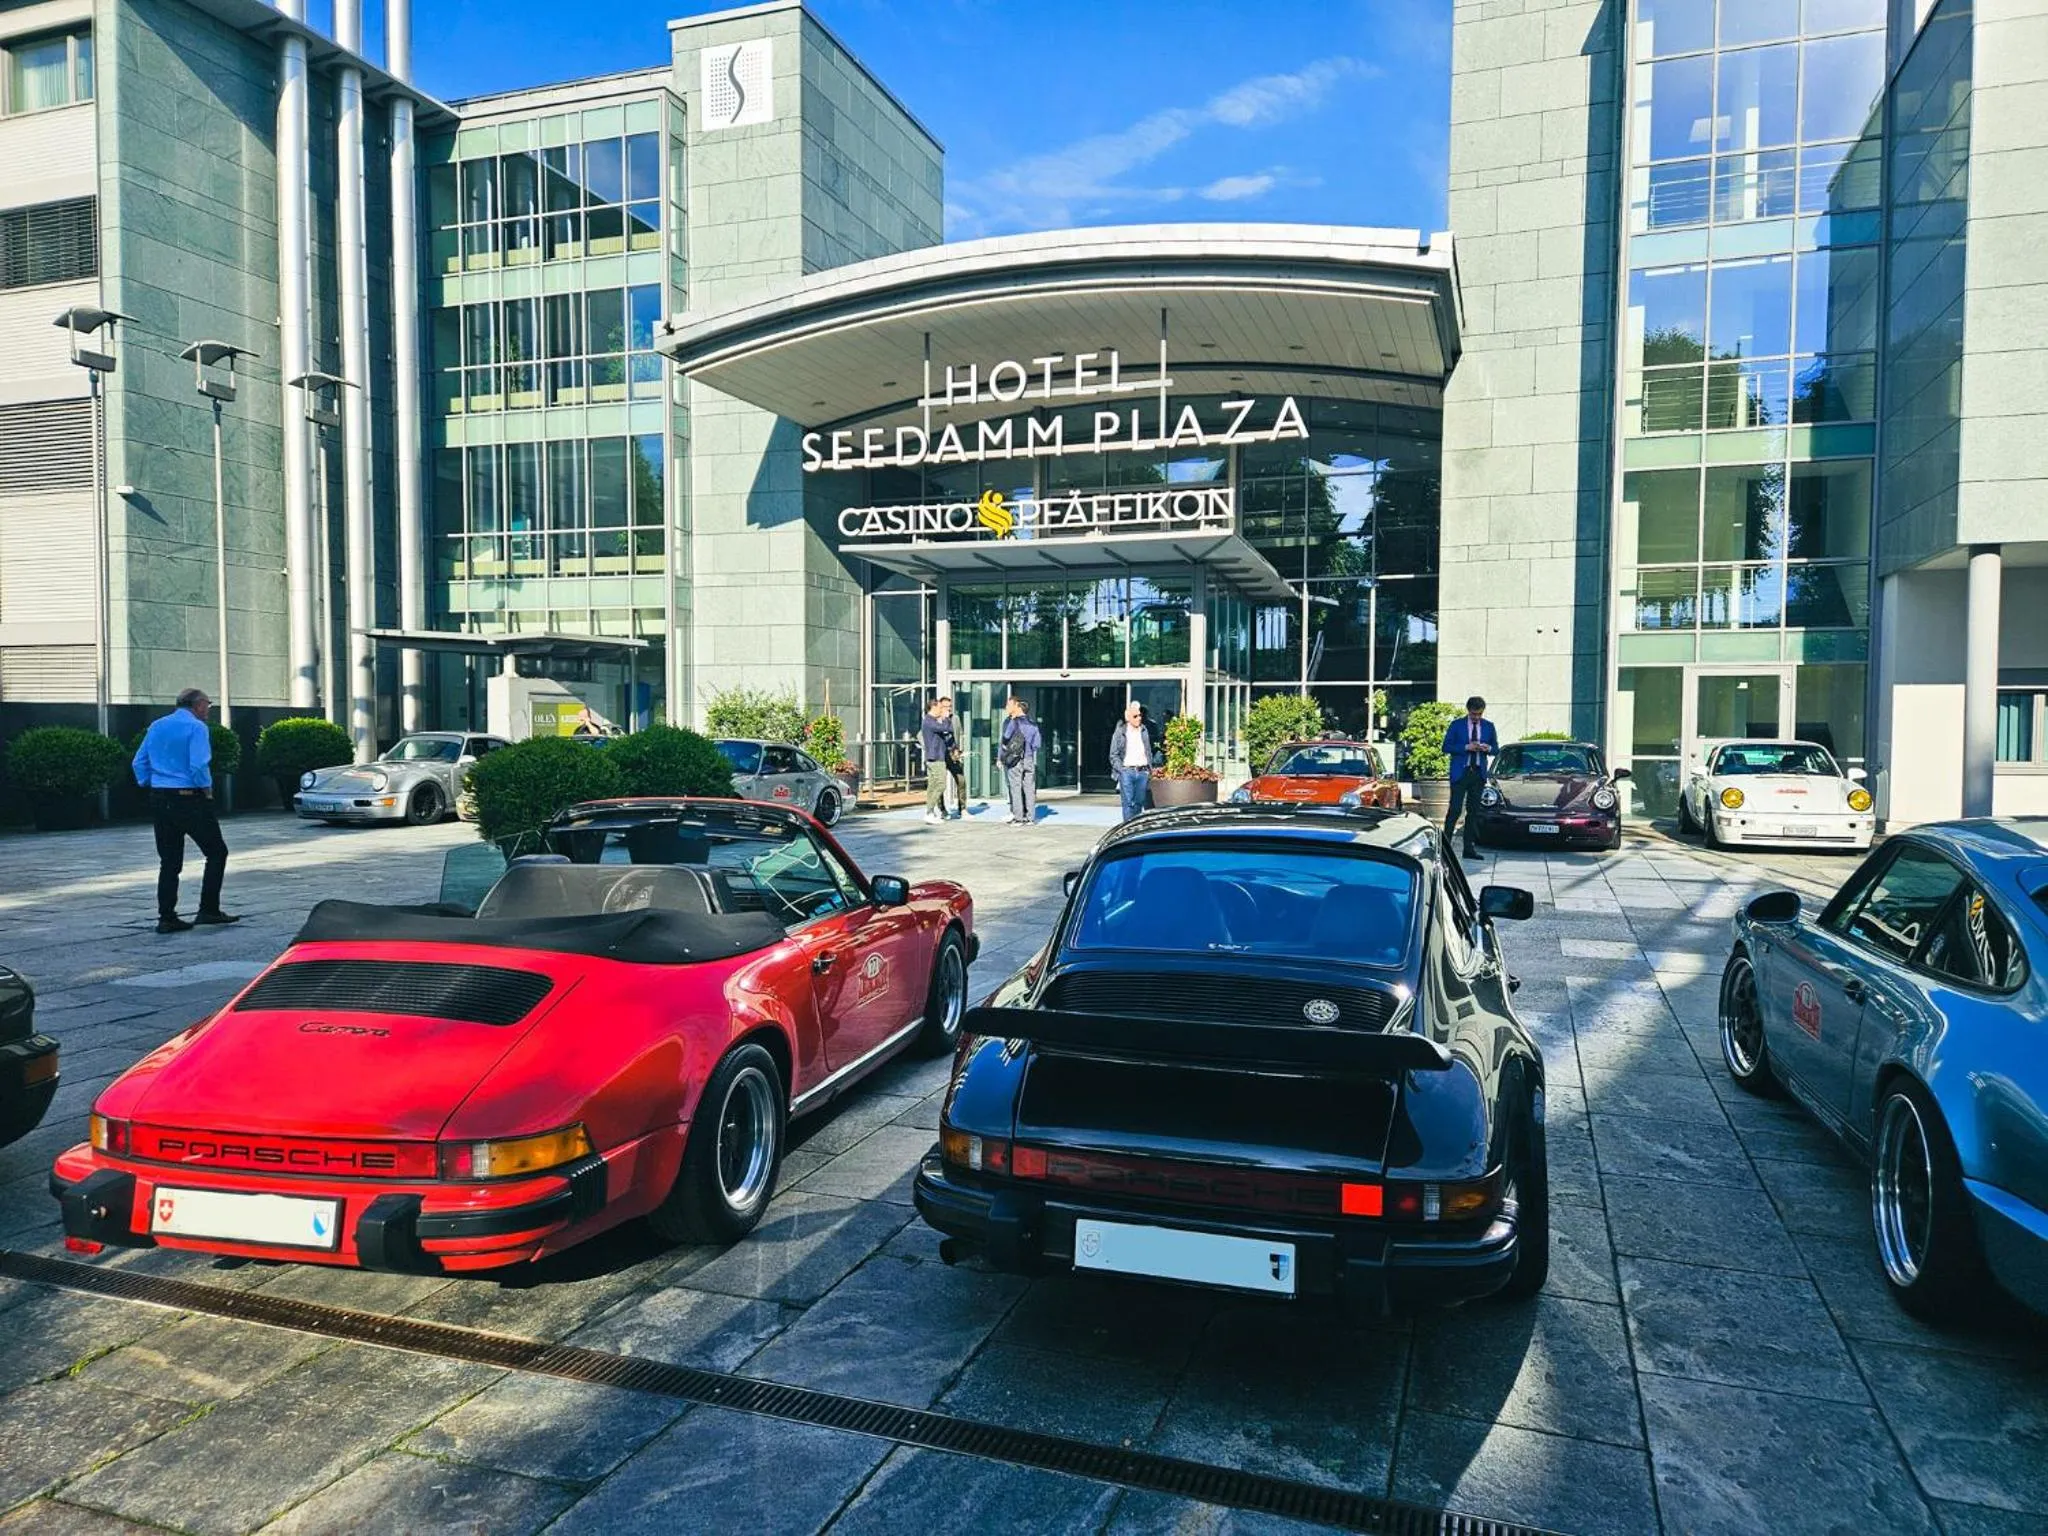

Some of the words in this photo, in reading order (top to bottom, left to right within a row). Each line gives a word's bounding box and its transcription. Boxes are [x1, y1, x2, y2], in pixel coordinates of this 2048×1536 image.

[946, 350, 1136, 404] HOTEL
[802, 415, 1064, 472] SEEDAMM
[1094, 396, 1308, 452] PLAZA
[838, 502, 973, 537] CASINO
[1018, 489, 1235, 528] PFÄFFIKON
[299, 1021, 390, 1037] Carrera
[158, 1138, 396, 1169] PORSCHE
